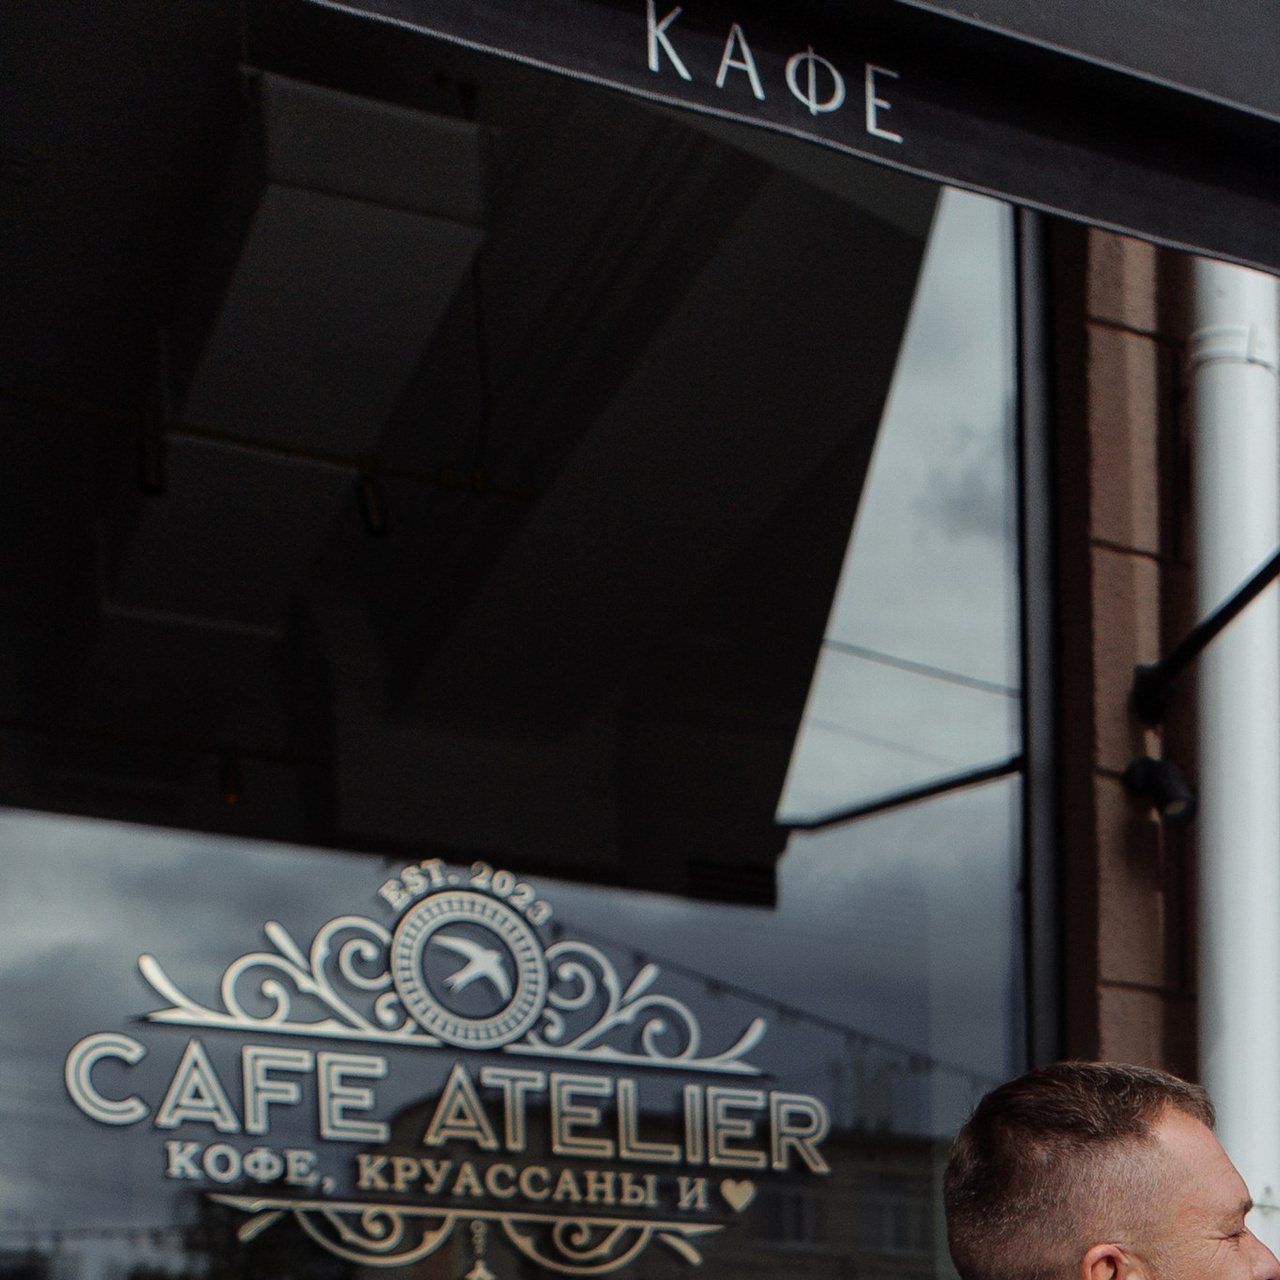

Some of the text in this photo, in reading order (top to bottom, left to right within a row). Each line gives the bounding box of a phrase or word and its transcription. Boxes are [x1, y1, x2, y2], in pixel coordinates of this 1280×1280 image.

[646, 0, 904, 144] КАФЕ
[377, 857, 554, 927] EST. 2023
[64, 1031, 832, 1174] CAFE ATELIER
[164, 1140, 710, 1211] КОФЕ, КРУАССАНЫ И
